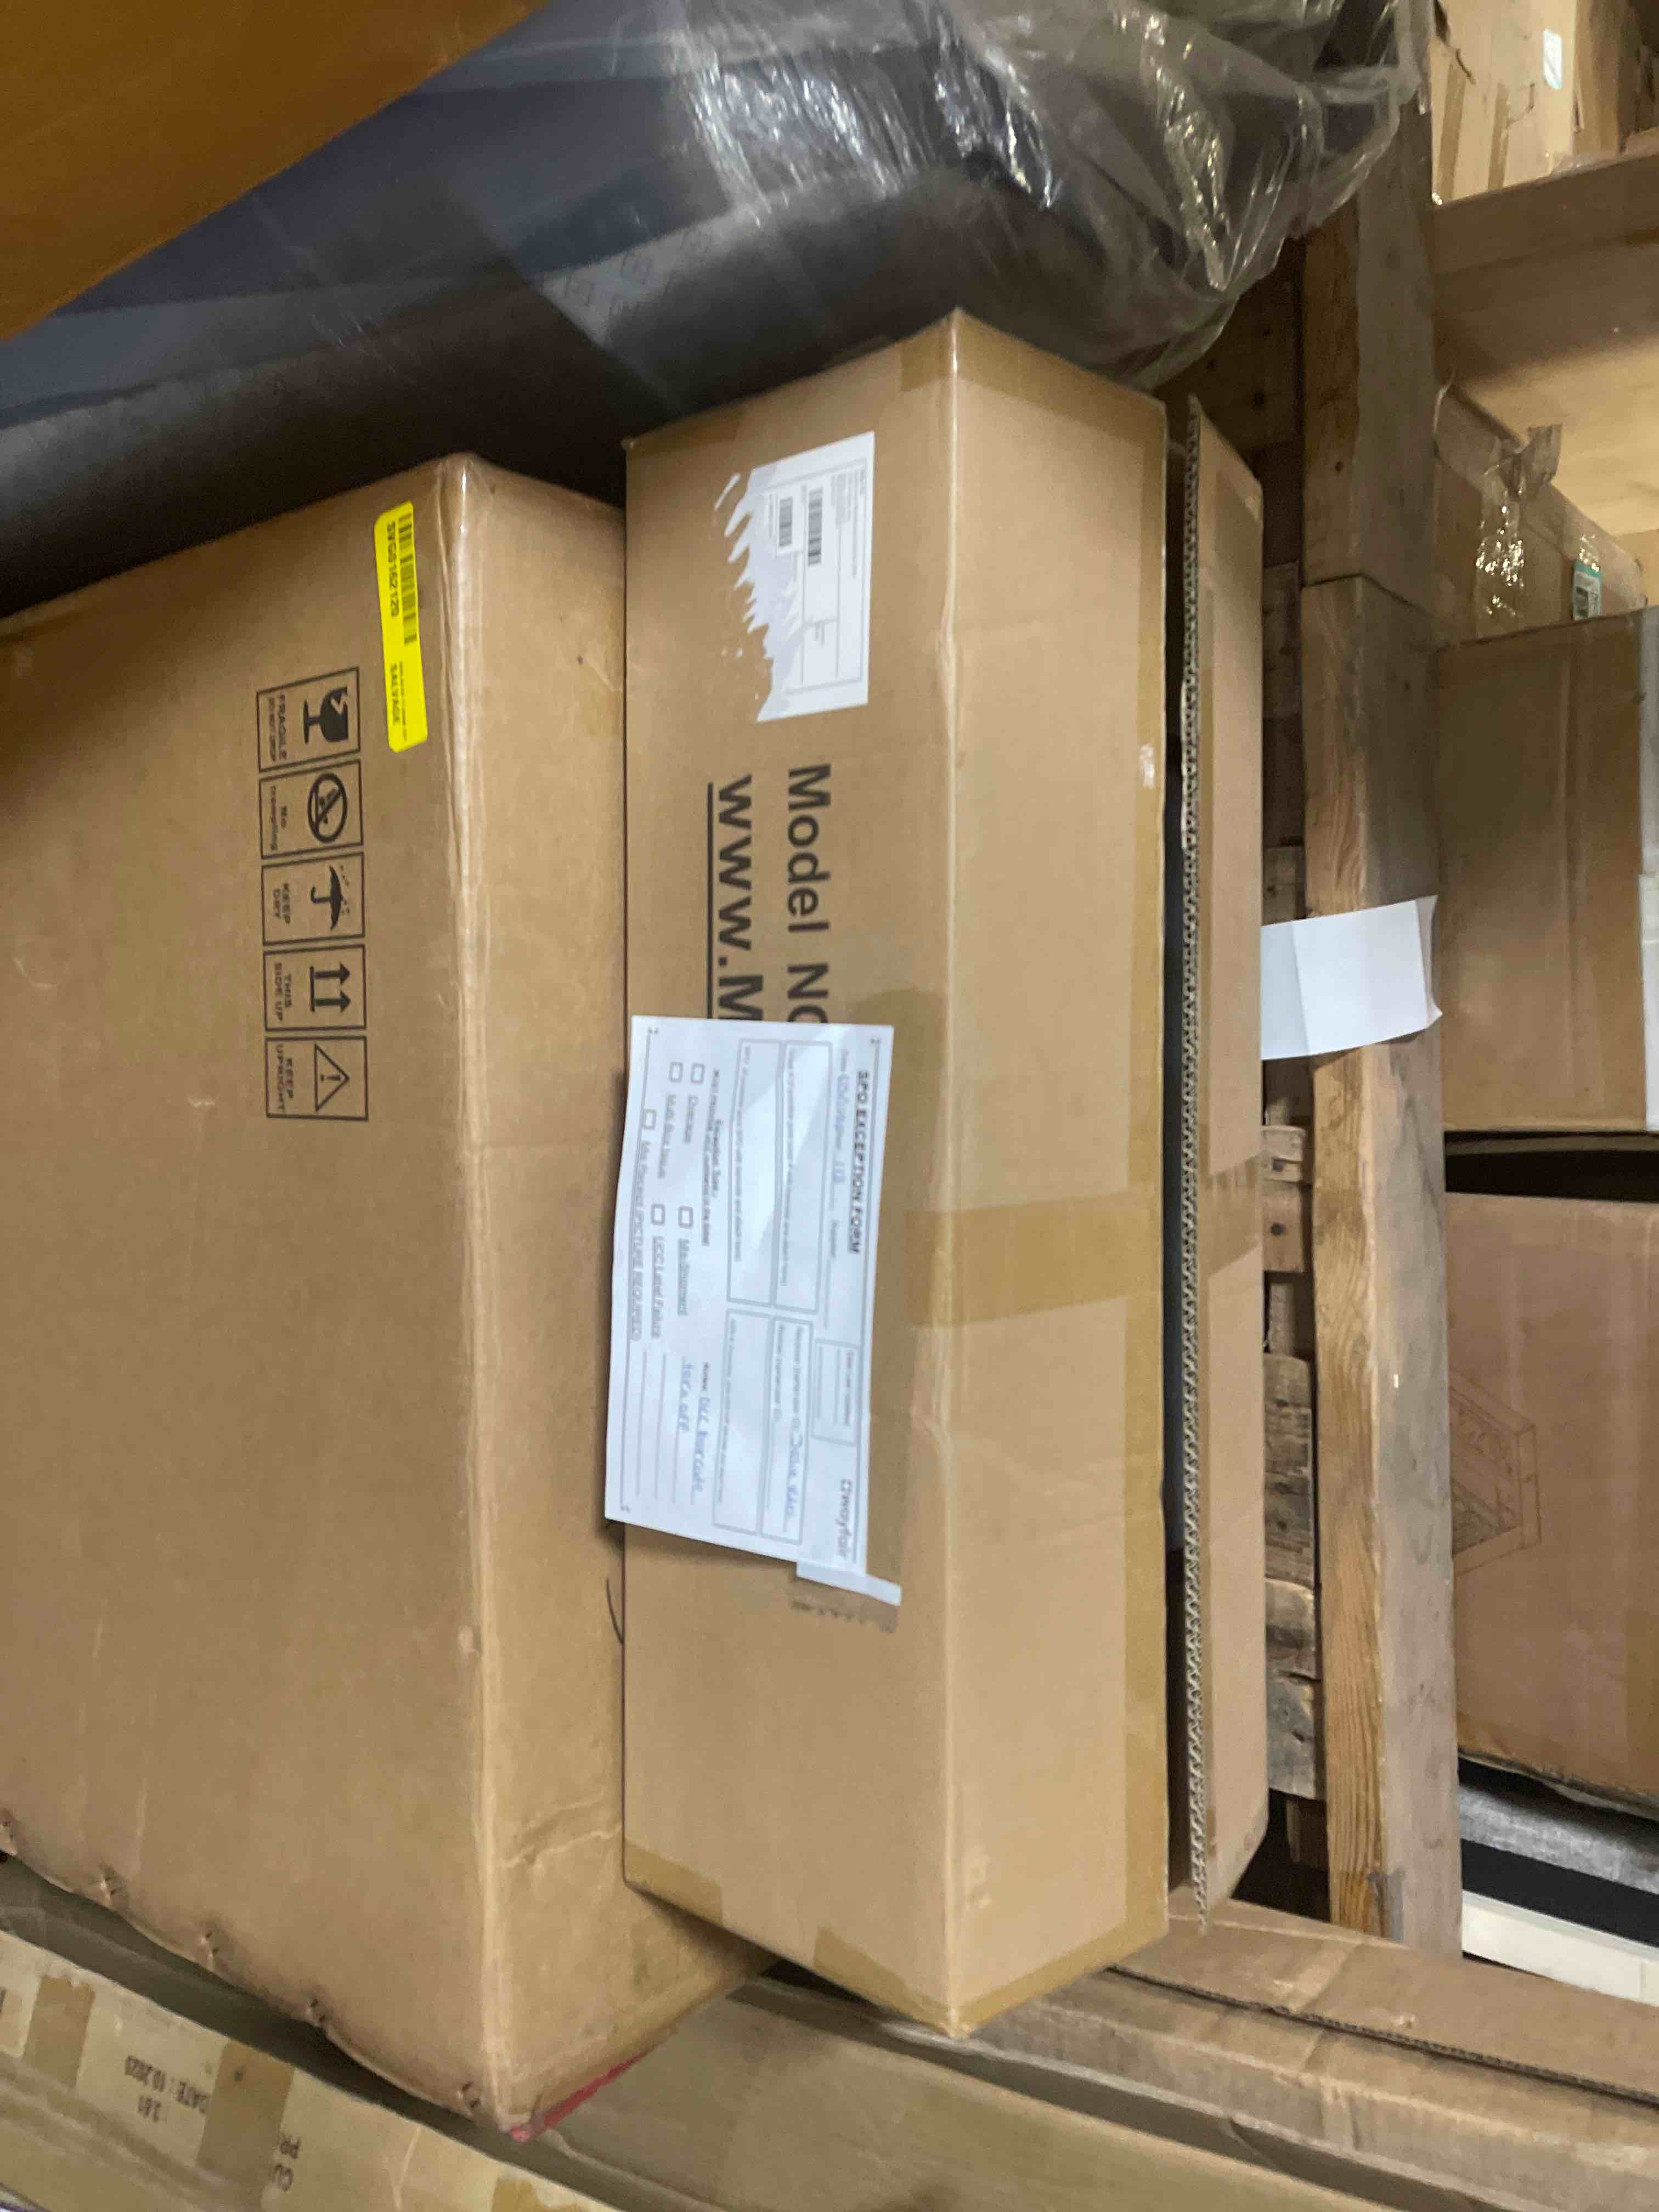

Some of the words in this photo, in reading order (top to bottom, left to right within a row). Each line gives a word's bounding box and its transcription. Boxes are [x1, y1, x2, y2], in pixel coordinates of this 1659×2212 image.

[278, 693, 287, 760] FRAGILE
[787, 763, 832, 933] Model
[273, 889, 281, 919] DRY
[283, 882, 291, 926] KEEP
[274, 961, 283, 992] SIDE
[275, 1001, 284, 1023] UP
[276, 1044, 285, 1112] UPRIGHT
[856, 1070, 870, 1103] SPO
[851, 1109, 867, 1201] EXCEPTION
[848, 1206, 863, 1255] FORM
[835, 1492, 853, 1561] wayfair
